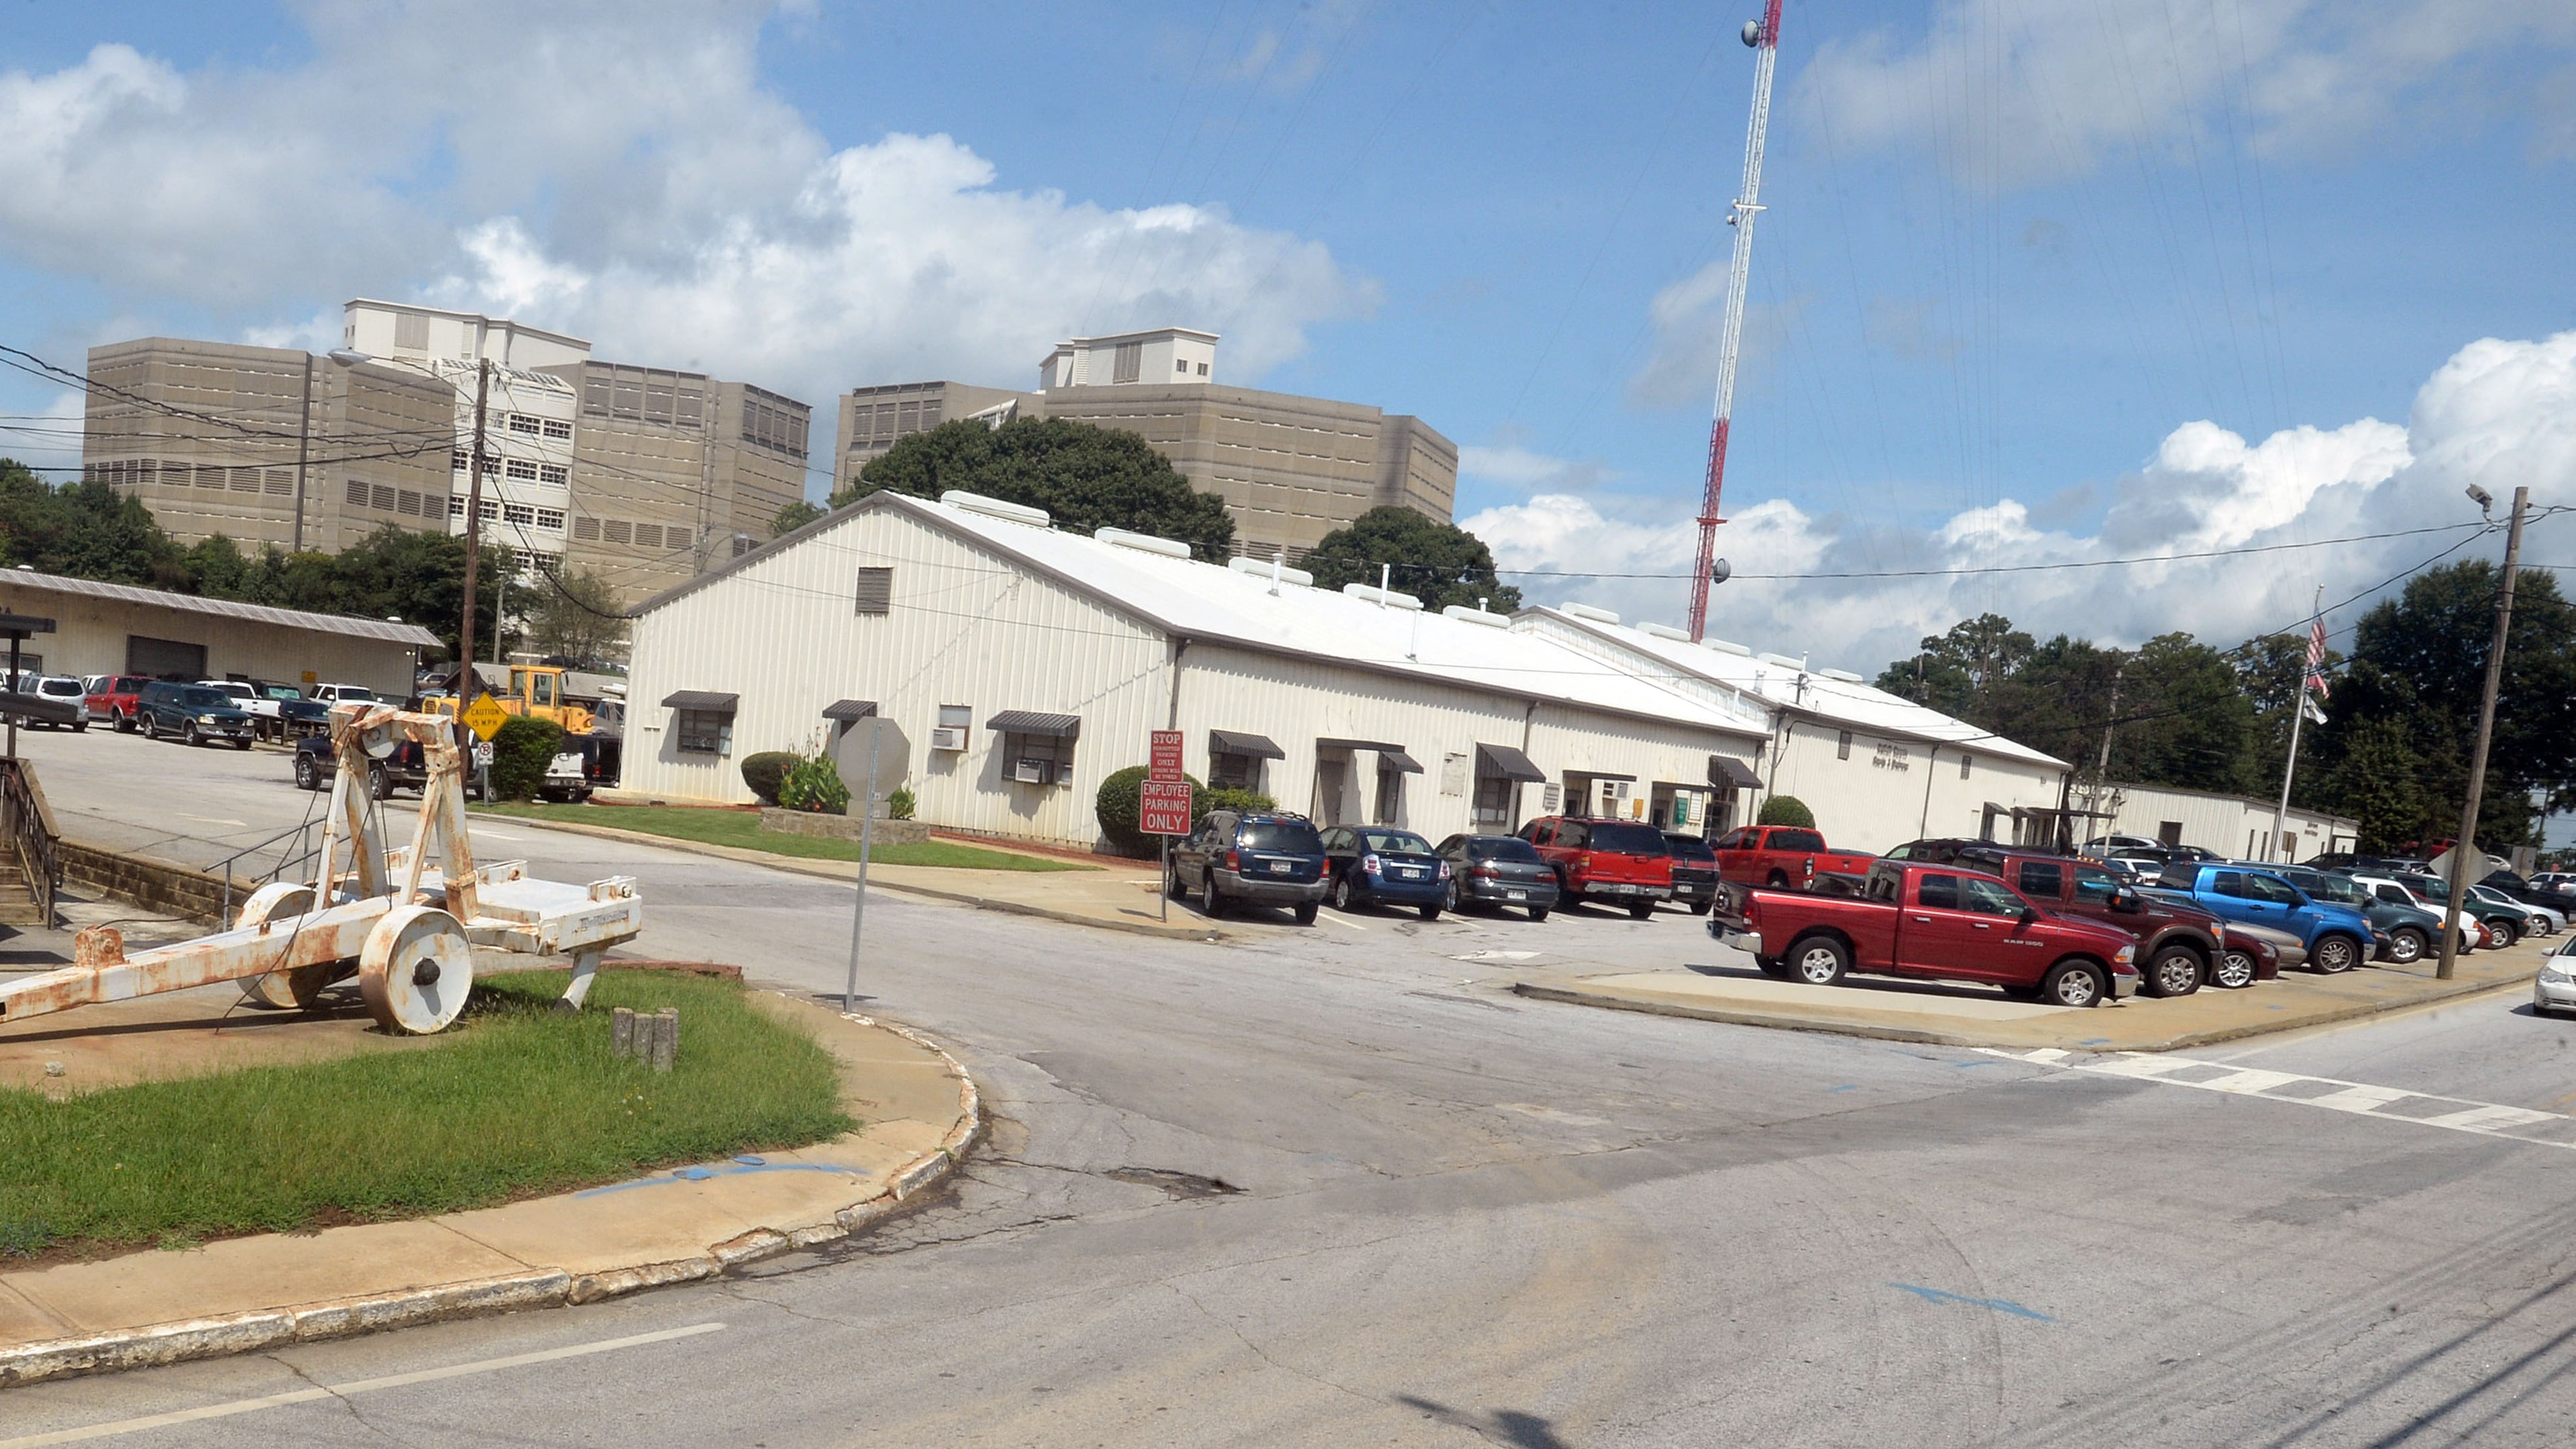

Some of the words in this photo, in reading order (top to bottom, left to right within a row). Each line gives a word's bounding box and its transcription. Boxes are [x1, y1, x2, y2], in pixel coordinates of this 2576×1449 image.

[1153, 734, 1181, 744] STOP
[1144, 784, 1189, 797] EMPLOYEE
[1145, 798, 1186, 812] PARKING
[1147, 813, 1183, 830] ONLY
